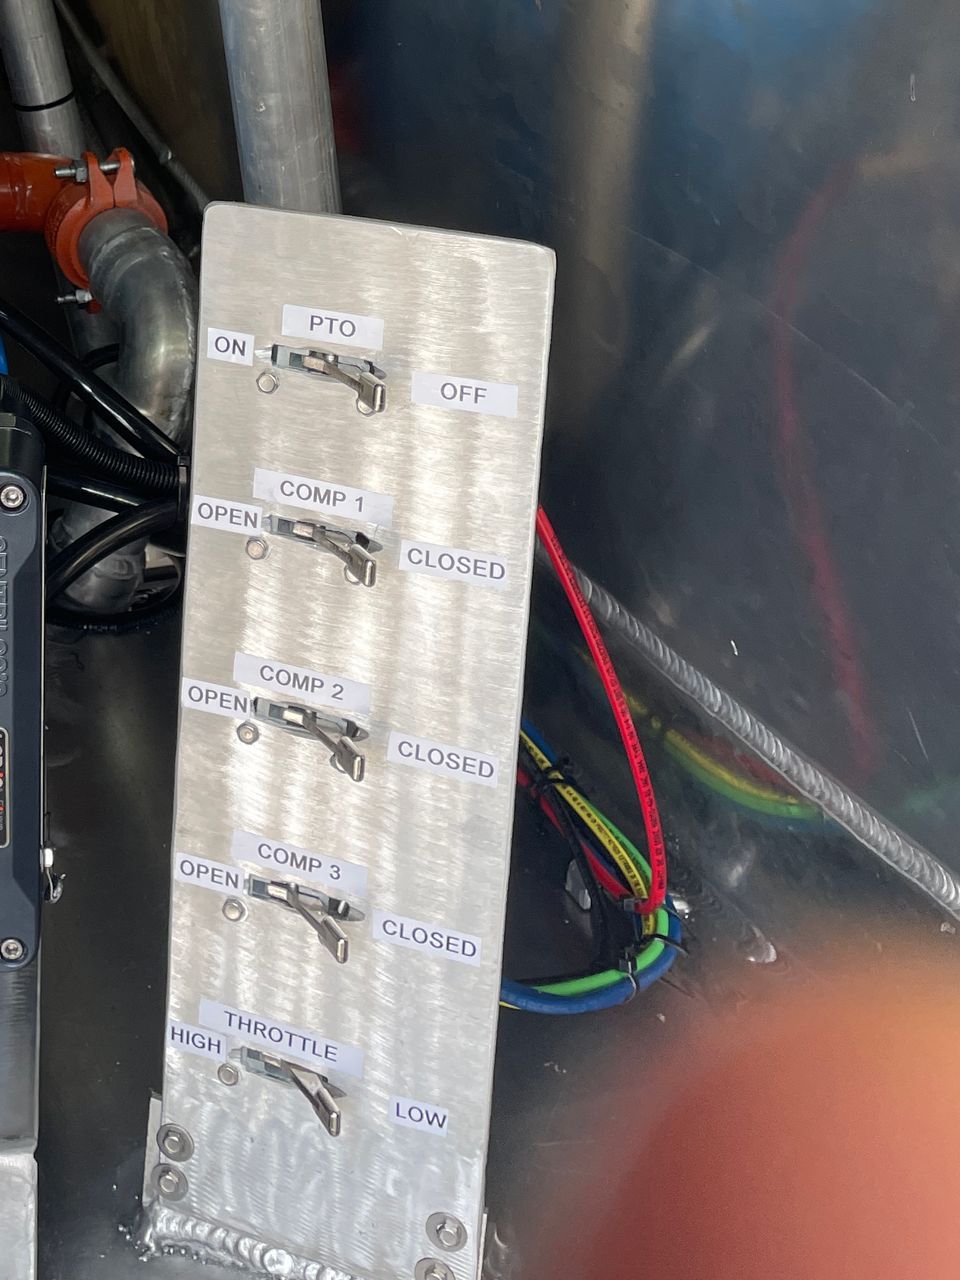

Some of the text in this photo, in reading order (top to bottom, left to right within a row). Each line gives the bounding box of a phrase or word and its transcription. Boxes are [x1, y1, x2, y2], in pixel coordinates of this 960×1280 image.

[310, 315, 356, 337] PTO
[214, 335, 246, 357] ON
[440, 382, 487, 405] OFF
[279, 480, 364, 513] COMP 1
[197, 502, 259, 529] OPEN
[407, 547, 506, 581] CLOSED
[259, 664, 345, 700] COMP 2
[188, 685, 248, 713] OPEN
[397, 741, 495, 778] CLOSED
[179, 860, 239, 888] OPEN
[257, 842, 342, 880] COMP 3
[382, 920, 478, 957] CLOSED
[170, 1027, 222, 1054] HIGH
[224, 1010, 339, 1062] THROTTLE
[395, 1102, 447, 1128] LOW
